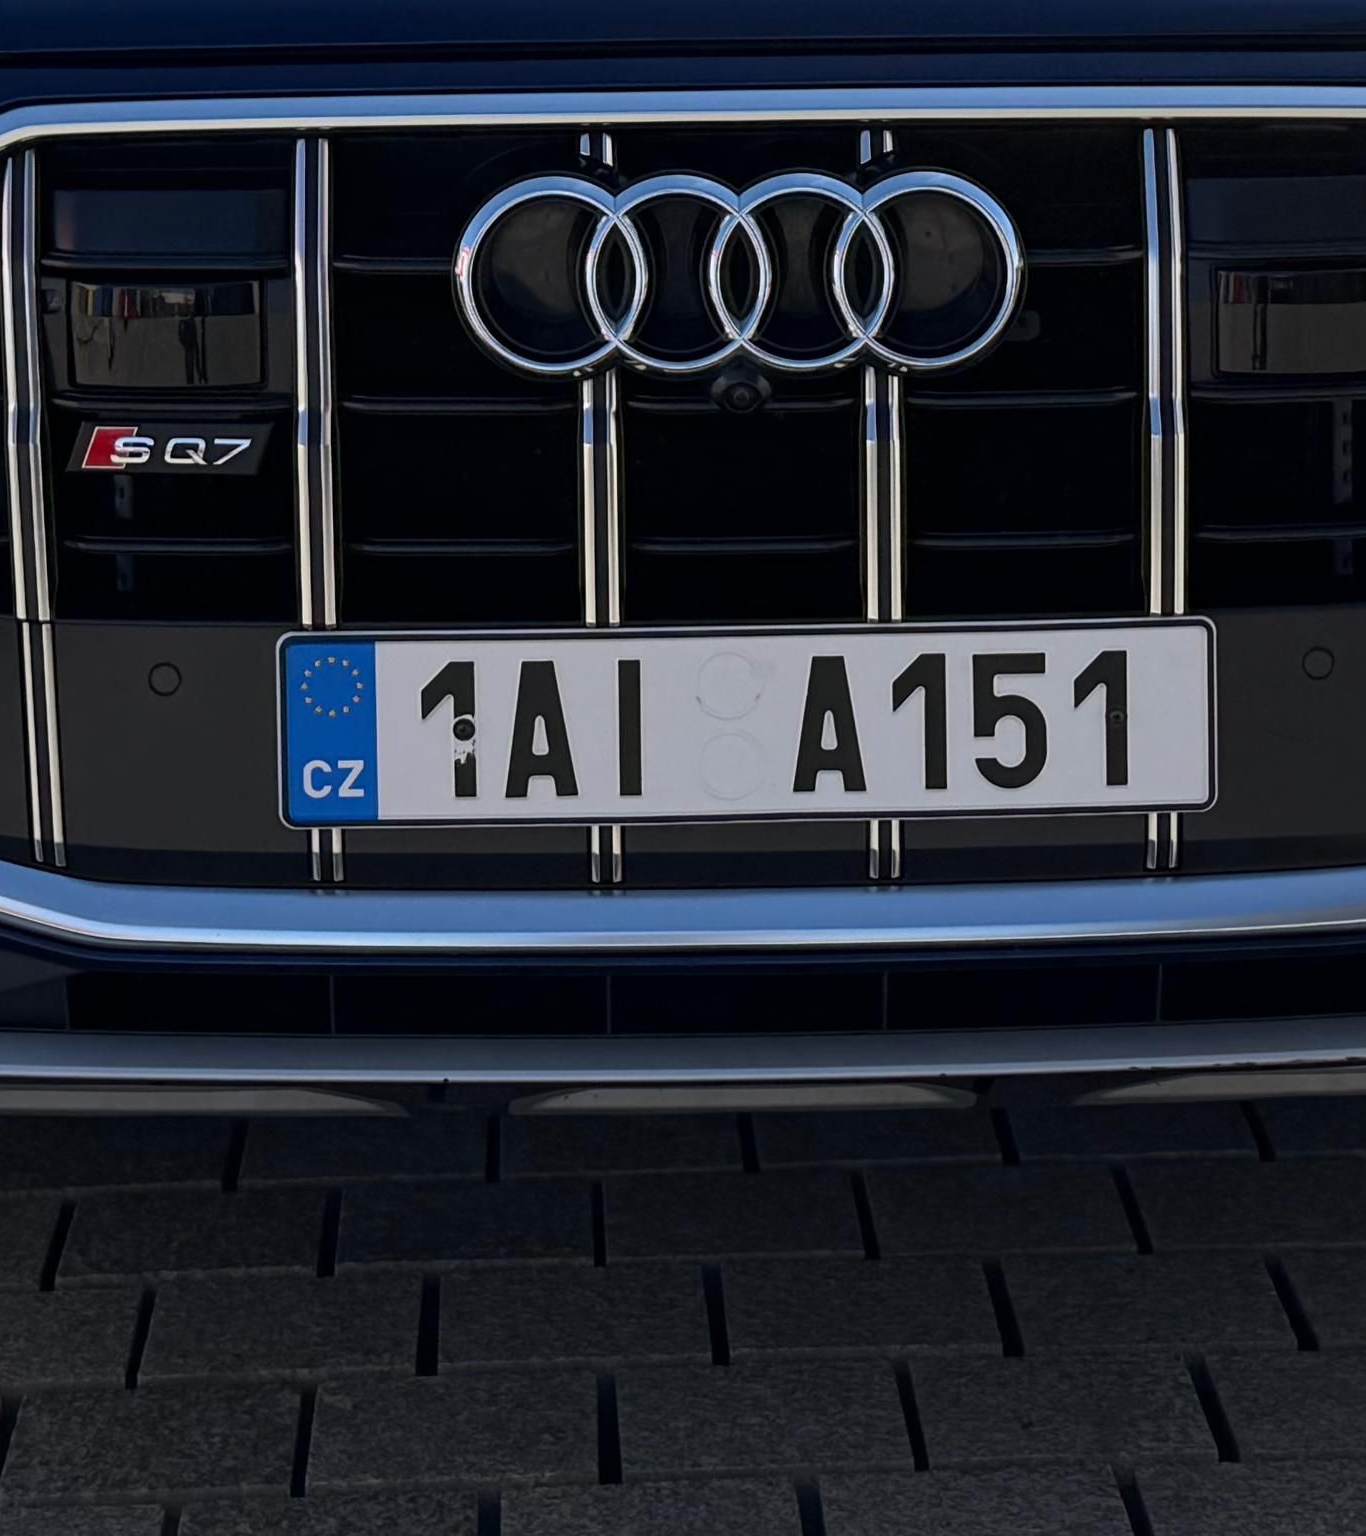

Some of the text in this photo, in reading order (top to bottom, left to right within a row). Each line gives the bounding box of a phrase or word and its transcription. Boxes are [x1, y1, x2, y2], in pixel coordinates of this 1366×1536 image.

[421, 650, 1129, 798] 1AI A151
[302, 760, 365, 798] CZ
